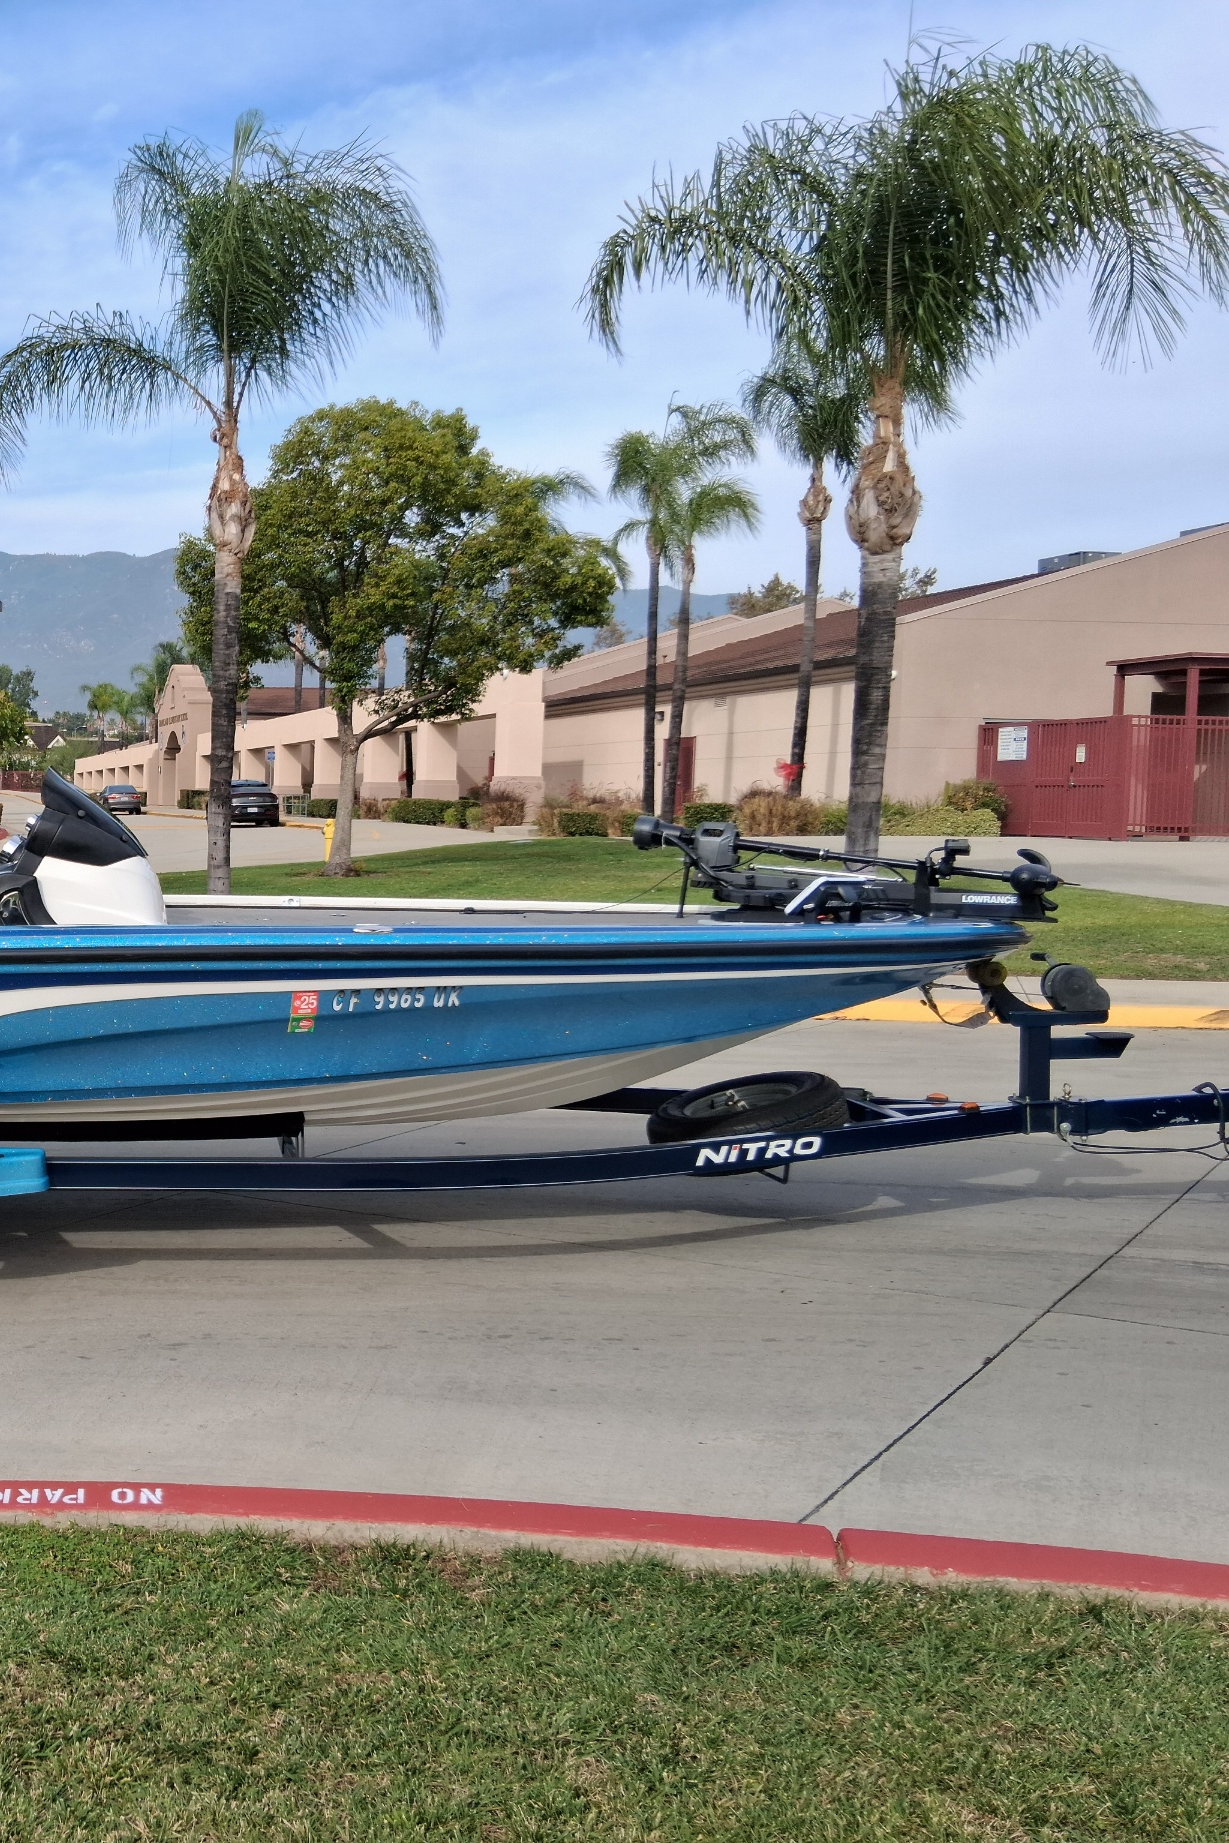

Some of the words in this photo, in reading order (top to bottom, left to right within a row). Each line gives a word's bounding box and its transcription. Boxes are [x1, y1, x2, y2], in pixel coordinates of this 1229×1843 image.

[961, 894, 1018, 905] LOWRANCE
[300, 995, 318, 1009] 25
[332, 990, 361, 1012] CF
[373, 987, 425, 1010] 9965
[433, 985, 463, 1008] UK
[110, 1488, 163, 1505] NO
